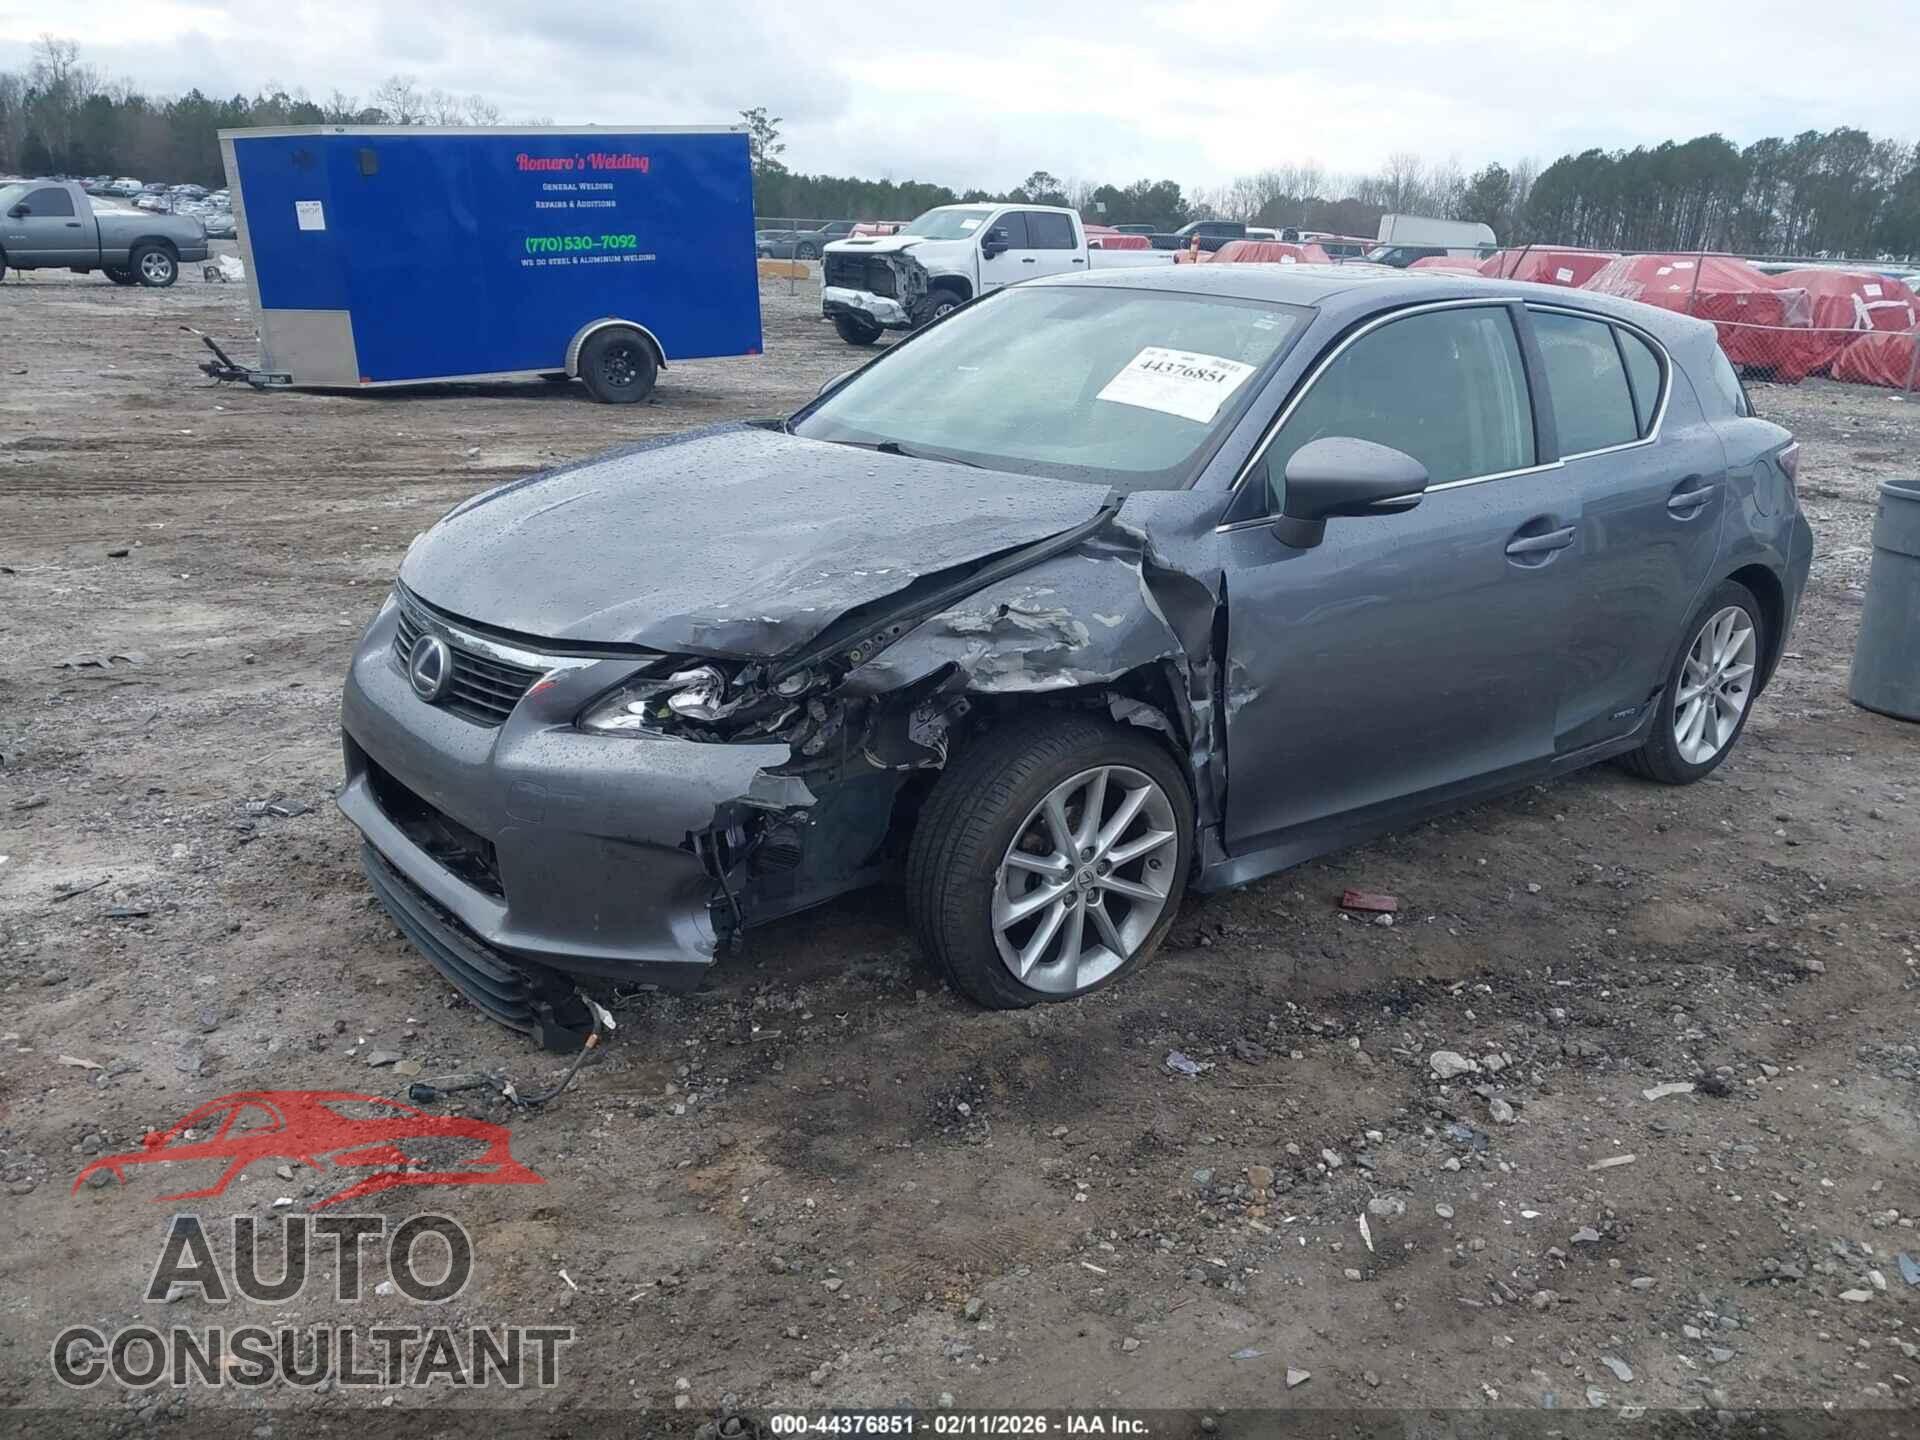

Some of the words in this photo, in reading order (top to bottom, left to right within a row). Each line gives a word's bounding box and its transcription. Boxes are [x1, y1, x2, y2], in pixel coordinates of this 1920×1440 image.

[516, 153, 585, 171] Romero's
[587, 153, 649, 173] Welding
[1140, 360, 1227, 383] 44376851
